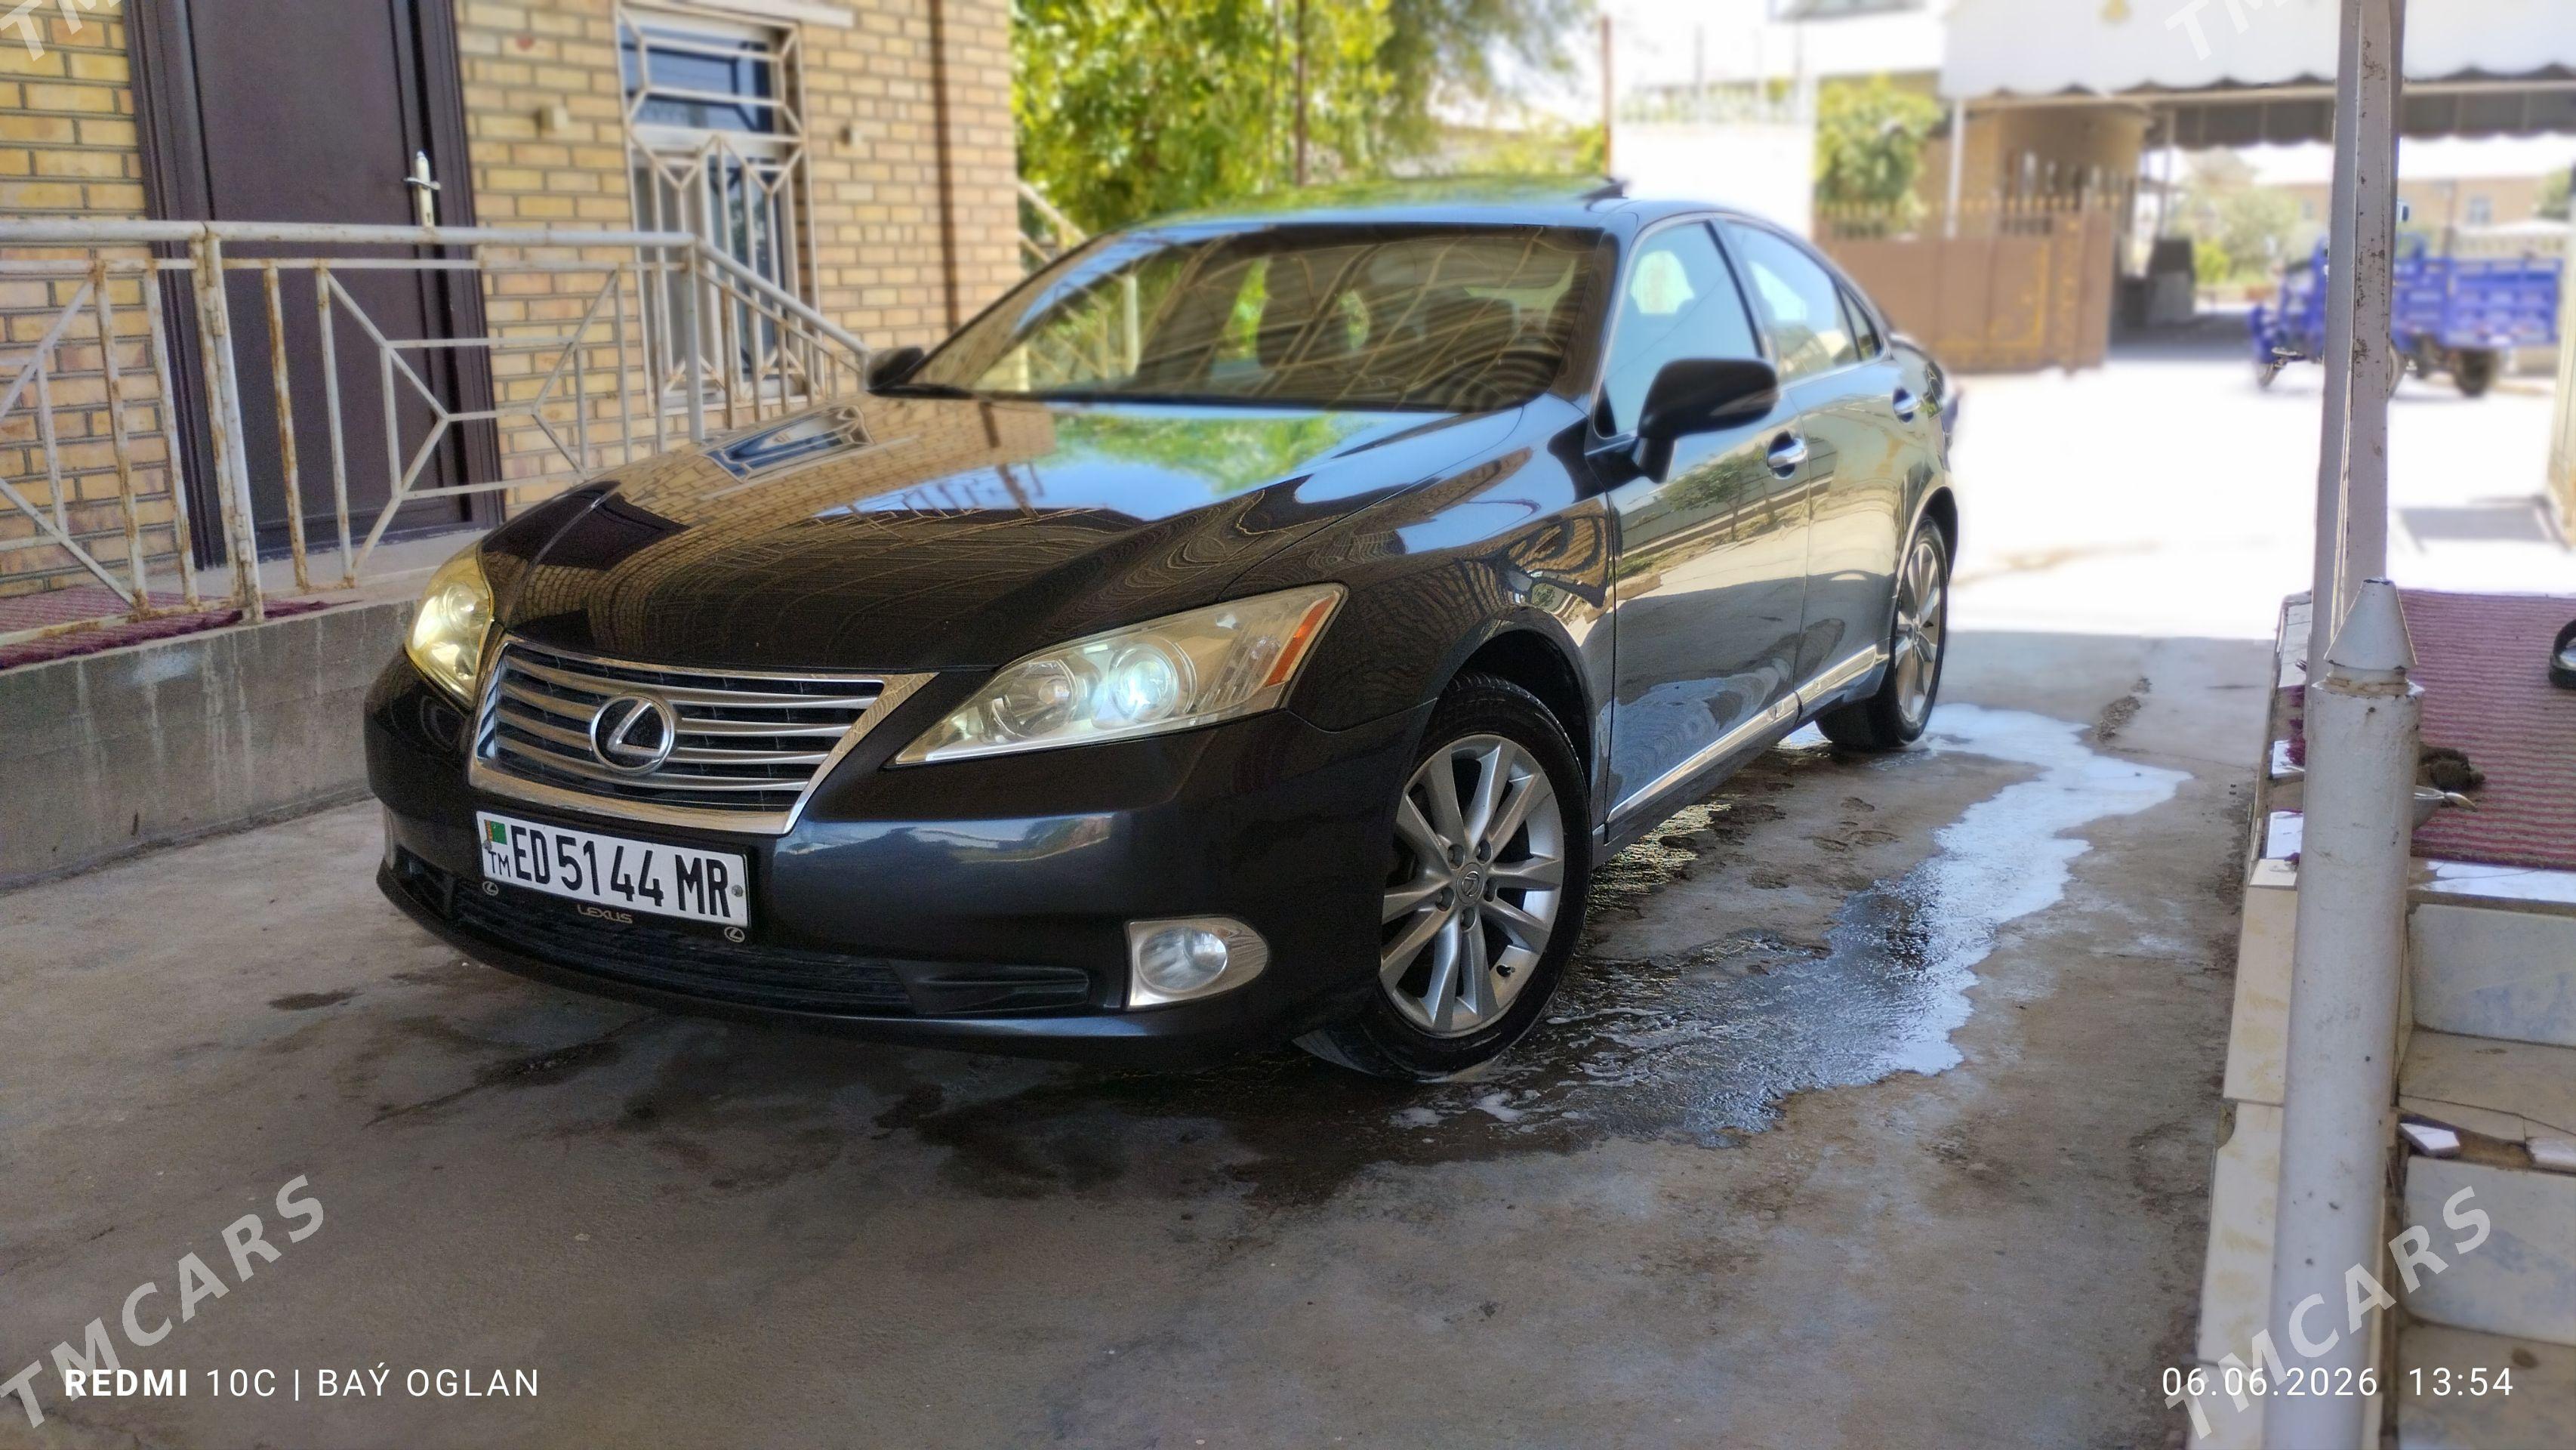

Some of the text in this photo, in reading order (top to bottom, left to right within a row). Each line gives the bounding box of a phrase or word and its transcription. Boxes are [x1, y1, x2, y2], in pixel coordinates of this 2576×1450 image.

[488, 850, 511, 878] TM
[510, 825, 731, 918] ED 5144 MR
[578, 905, 633, 924] LEXUS
